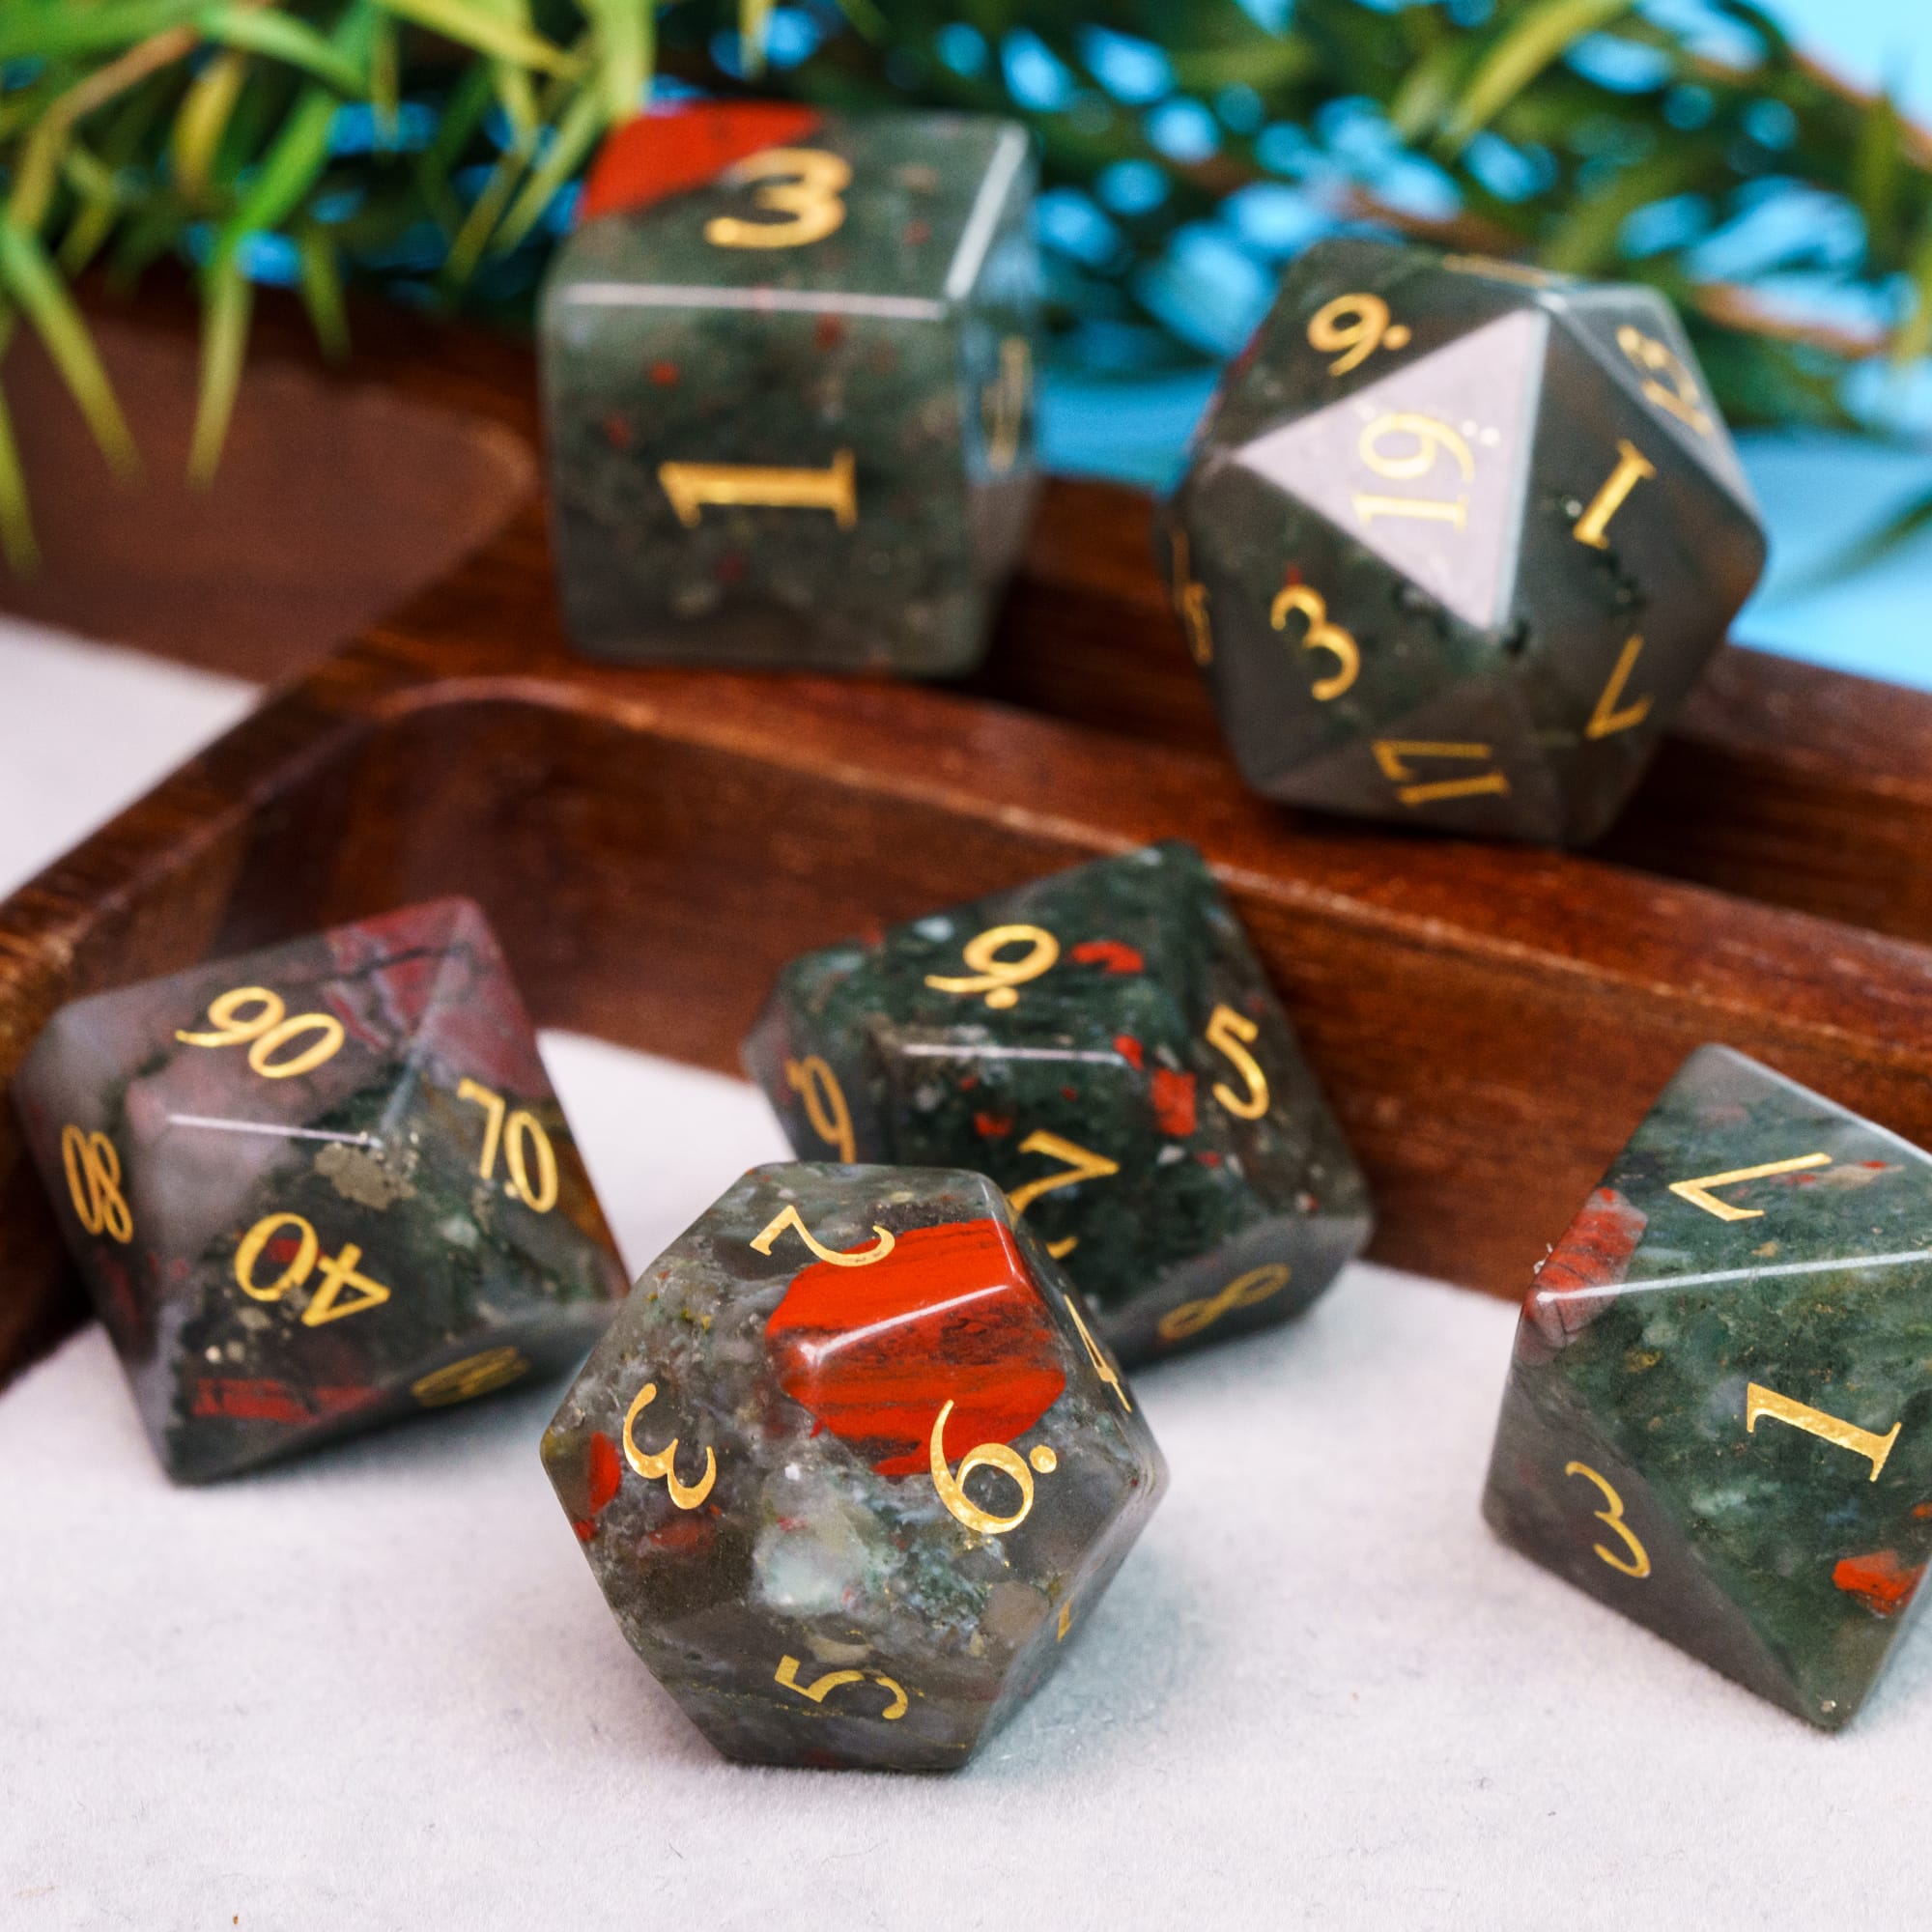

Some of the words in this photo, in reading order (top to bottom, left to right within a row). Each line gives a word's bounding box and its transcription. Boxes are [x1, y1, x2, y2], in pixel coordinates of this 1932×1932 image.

[703, 147, 852, 249] 3
[658, 448, 859, 532] 1
[1351, 412, 1477, 533] 19
[1572, 438, 1657, 550] 1
[1270, 584, 1361, 701] 3
[1583, 633, 1654, 740] 7
[1372, 739, 1510, 808] 17
[175, 985, 345, 1079] 90
[1206, 1005, 1270, 1120] 5
[61, 1124, 133, 1244] 80
[457, 1077, 558, 1214] 70
[1668, 1151, 1833, 1222] 7
[234, 1211, 391, 1327] 40
[749, 1205, 895, 1268] 2
[1157, 1262, 1291, 1341] 8
[621, 1382, 717, 1510] 3
[1746, 1381, 1902, 1484] 1
[1564, 1460, 1651, 1578] 3
[774, 1653, 909, 1720] 5
